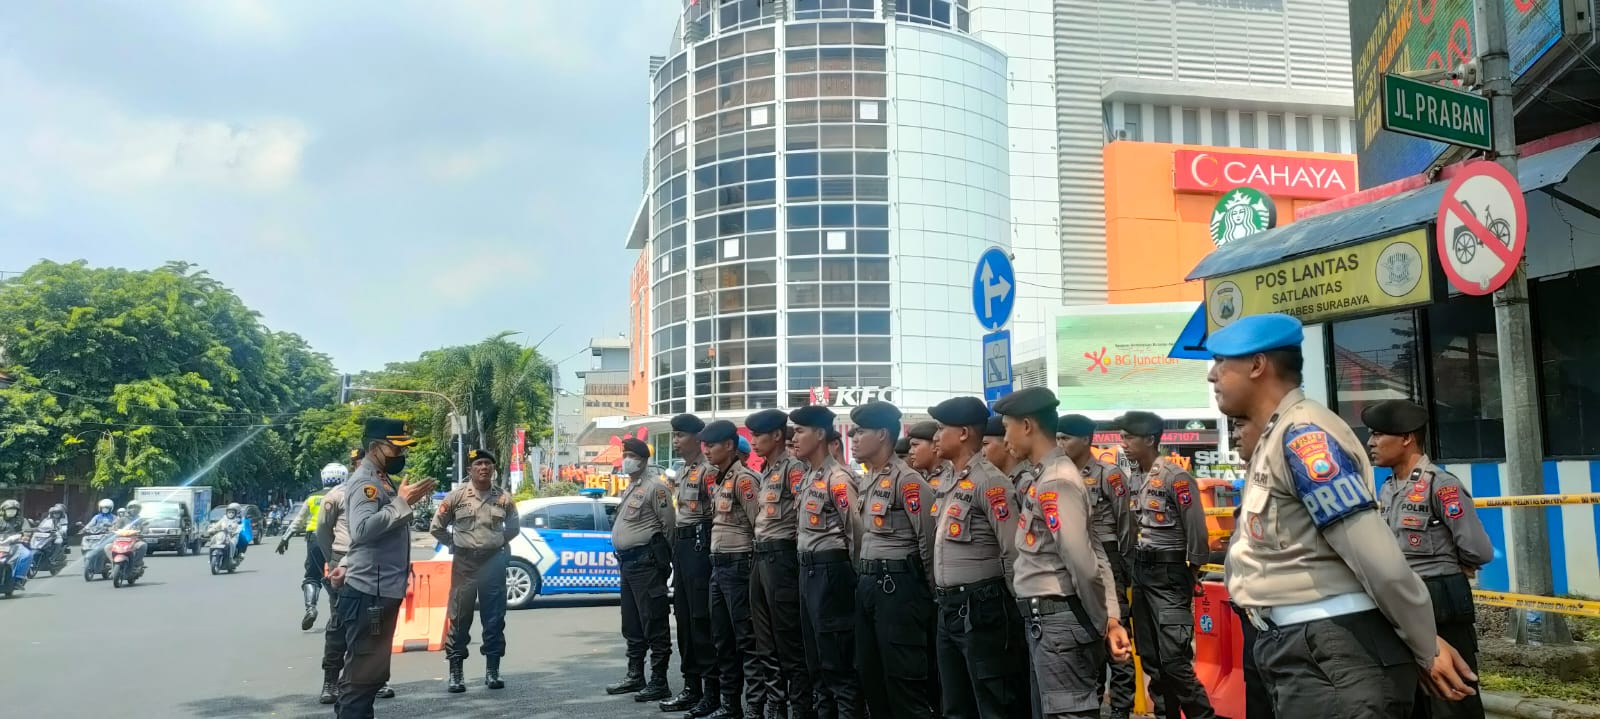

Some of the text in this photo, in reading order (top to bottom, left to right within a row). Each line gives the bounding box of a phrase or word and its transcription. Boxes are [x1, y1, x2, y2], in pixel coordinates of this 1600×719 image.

[1415, 92, 1485, 136] PRABAN
[1223, 161, 1347, 190] CAHAYA
[1255, 253, 1359, 290] POS LANTAS
[1271, 280, 1343, 305] SATLANTAS
[1316, 294, 1370, 313] SURABAYA
[1114, 354, 1131, 366] BG
[832, 385, 900, 406] KFC
[1401, 503, 1429, 513] POLRI
